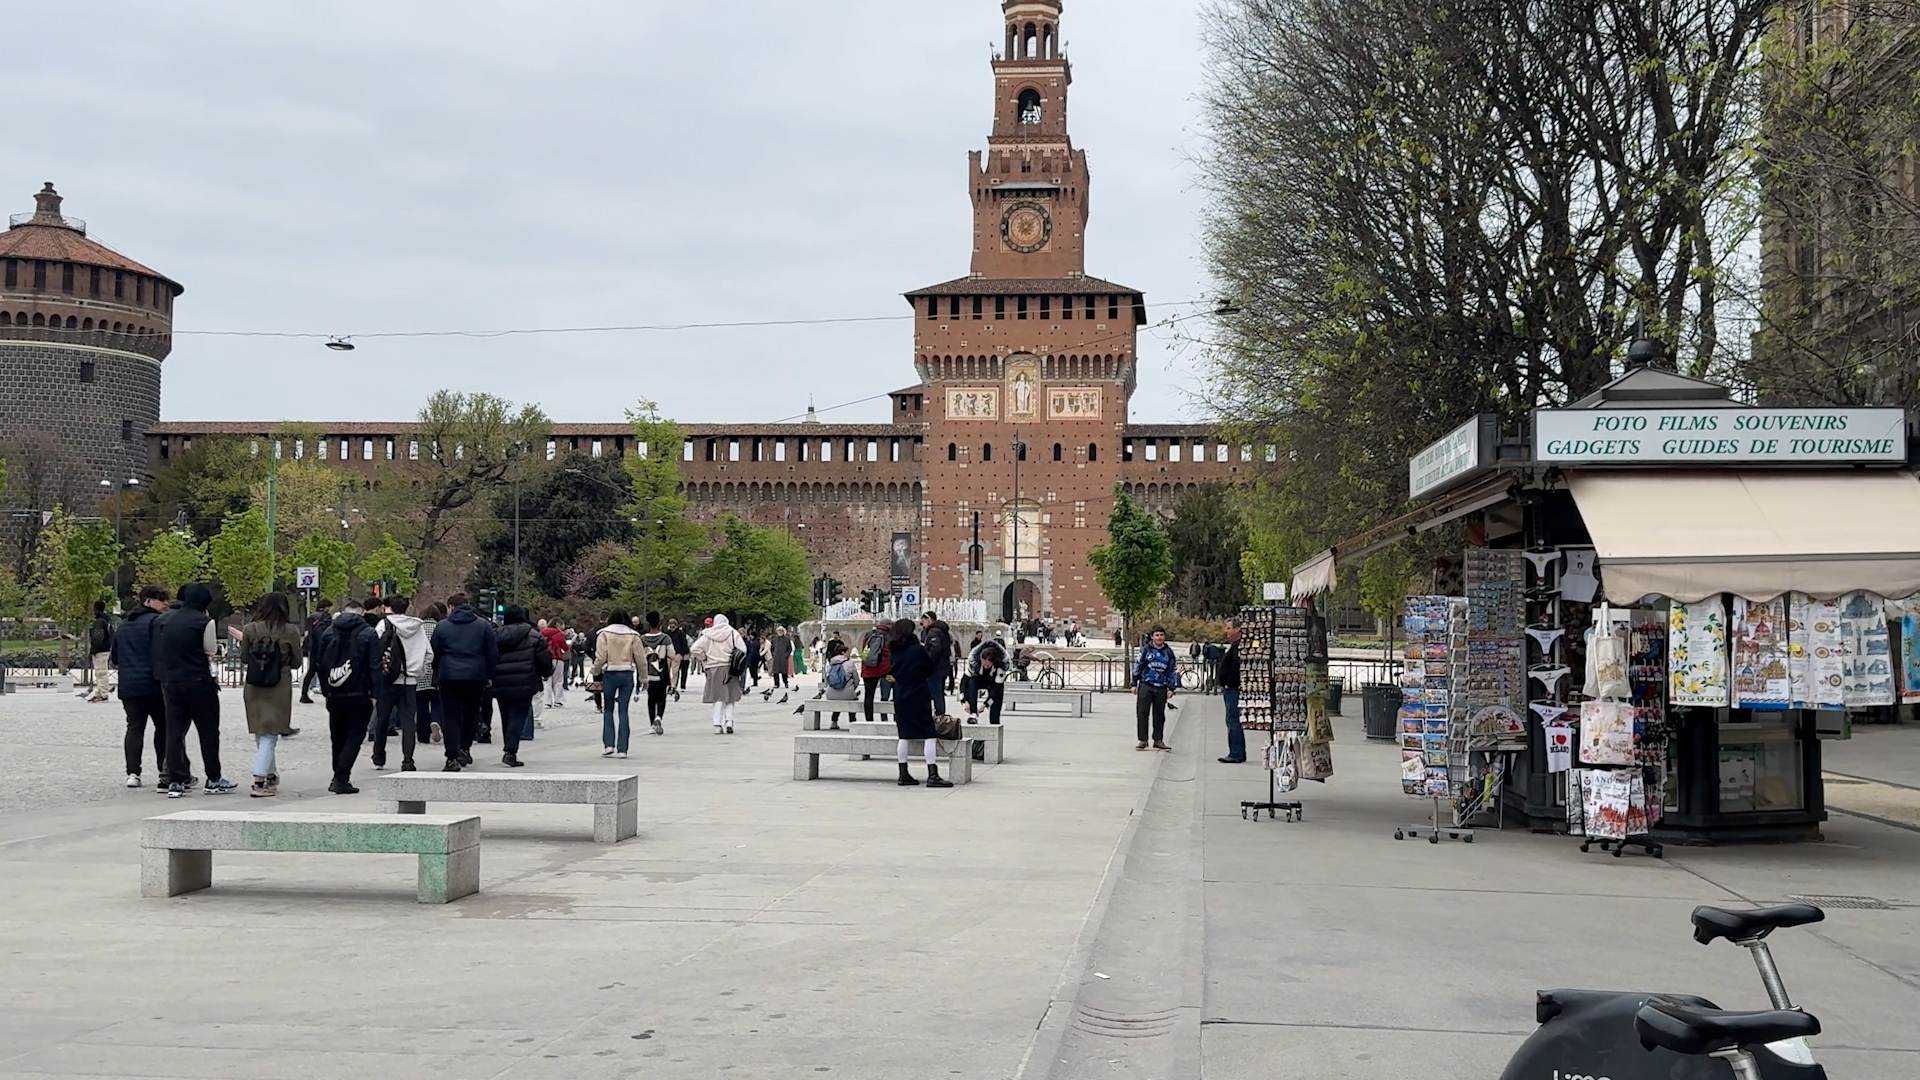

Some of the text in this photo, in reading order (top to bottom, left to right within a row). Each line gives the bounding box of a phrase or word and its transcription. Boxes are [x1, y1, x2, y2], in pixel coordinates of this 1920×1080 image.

[1592, 415, 1848, 431] FOTO FILMS SOUVENIRS
[1547, 439, 1894, 455] GADGETS GUIDES DE TOURISME
[330, 659, 351, 681] NIKE
